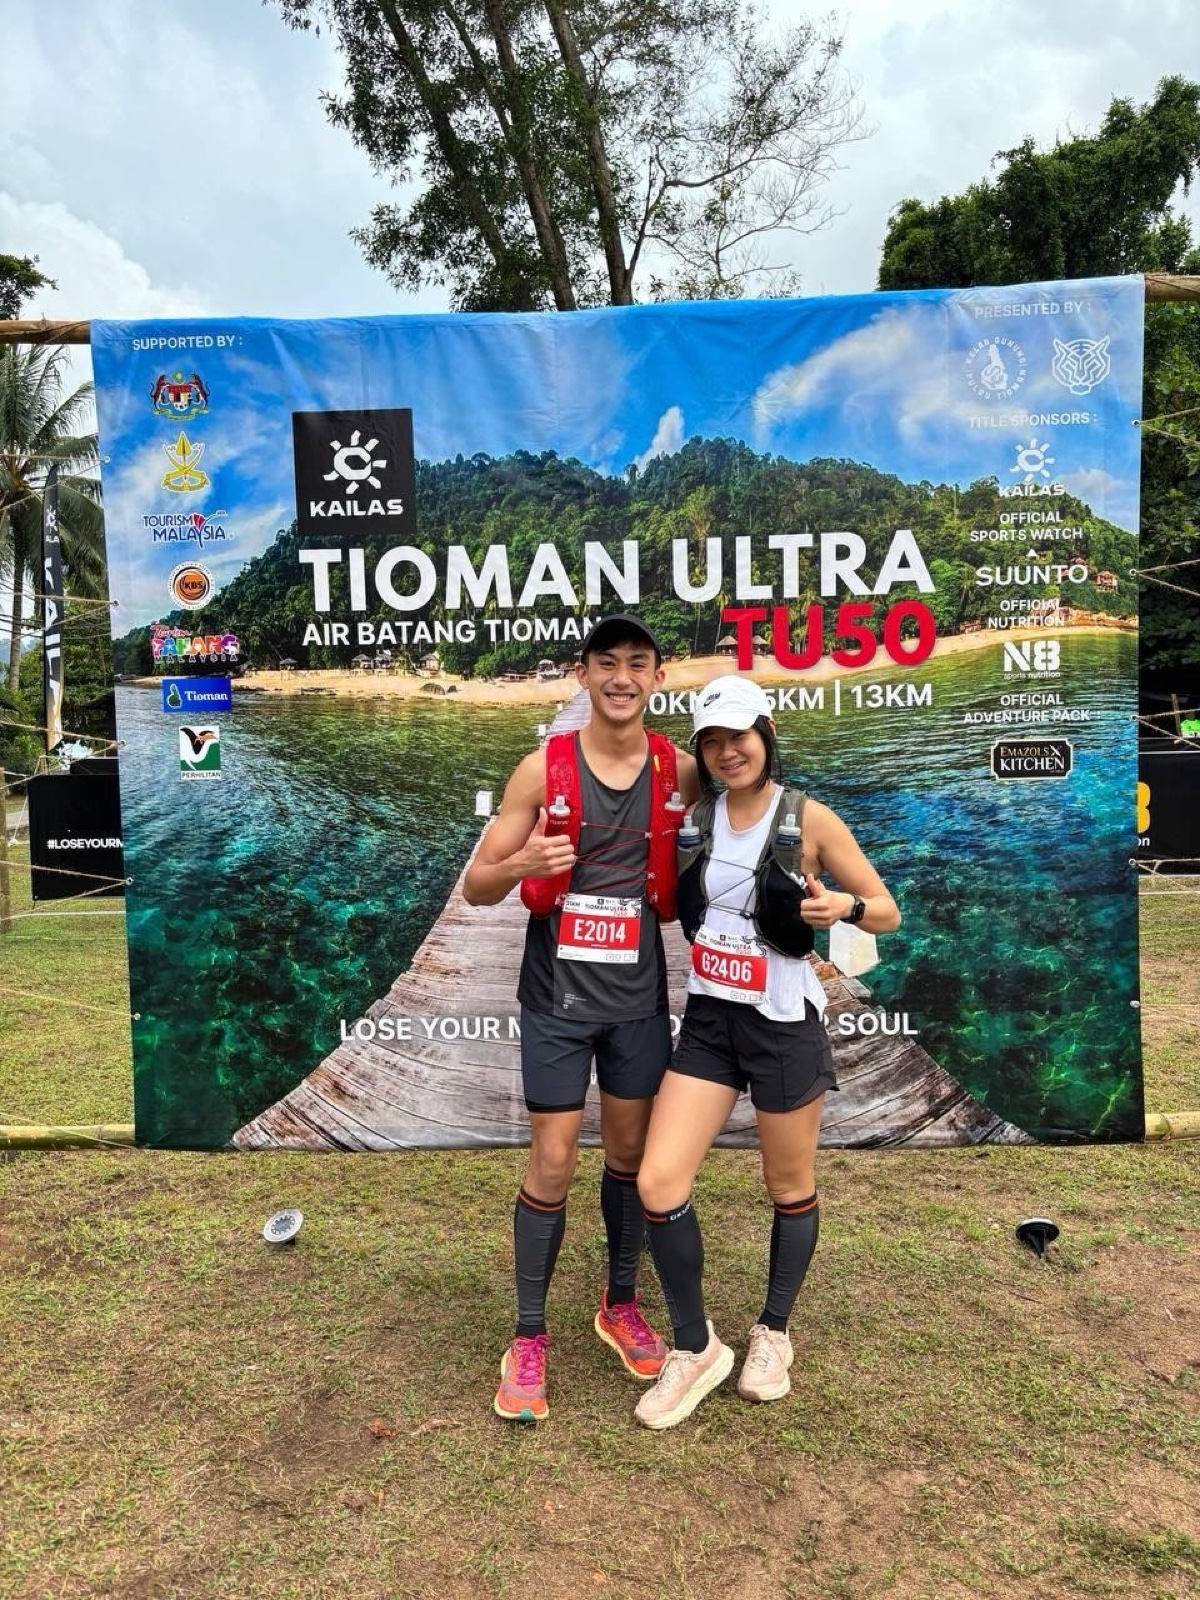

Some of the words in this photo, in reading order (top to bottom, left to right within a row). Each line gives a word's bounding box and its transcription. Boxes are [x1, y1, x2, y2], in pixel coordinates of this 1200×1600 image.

[974, 302, 1060, 319] PRESENTED
[1063, 300, 1084, 314] BY
[132, 335, 214, 351] SUPPORTED
[216, 335, 235, 347] BY
[968, 414, 1008, 430] TITLE
[1009, 412, 1090, 428] SPONSORS
[999, 484, 1065, 497] KAILAS
[309, 499, 404, 517] KAILAS
[143, 514, 193, 527] TOURISM
[1000, 511, 1064, 525] OFFICIAL
[153, 525, 226, 548] MALAYSIA
[970, 529, 1027, 542] SPORTS
[1030, 527, 1083, 541] WATCH
[299, 540, 640, 611] TIOMAN
[672, 529, 936, 603] ULTRA
[975, 564, 1089, 586] SUUNTO
[184, 580, 204, 591] KBS
[1000, 599, 1062, 613] OFFICIAL
[988, 615, 1065, 629] NUTRITION
[302, 622, 349, 646] AIR
[357, 620, 476, 645] BATANG
[723, 599, 936, 671] TU50
[152, 634, 240, 656] PAHANG
[153, 652, 239, 664] MALAYSIA
[1003, 640, 1060, 671] N8
[1028, 670, 1061, 679] nutrition
[184, 690, 228, 701] Tioman
[764, 686, 824, 712] 5KM
[851, 684, 933, 708] 13KM
[1000, 694, 1064, 706] OFFICIAL
[964, 709, 1050, 723] ADVENTURE
[1053, 709, 1090, 721] PACK
[1000, 756, 1065, 770] KITCHEN
[181, 772, 221, 780] PERHILITAN
[574, 918, 626, 944] E2014
[702, 951, 752, 983] G2406
[340, 1018, 412, 1041] LOSE
[420, 1017, 500, 1040] YOUR
[838, 1012, 918, 1035] SOUL
